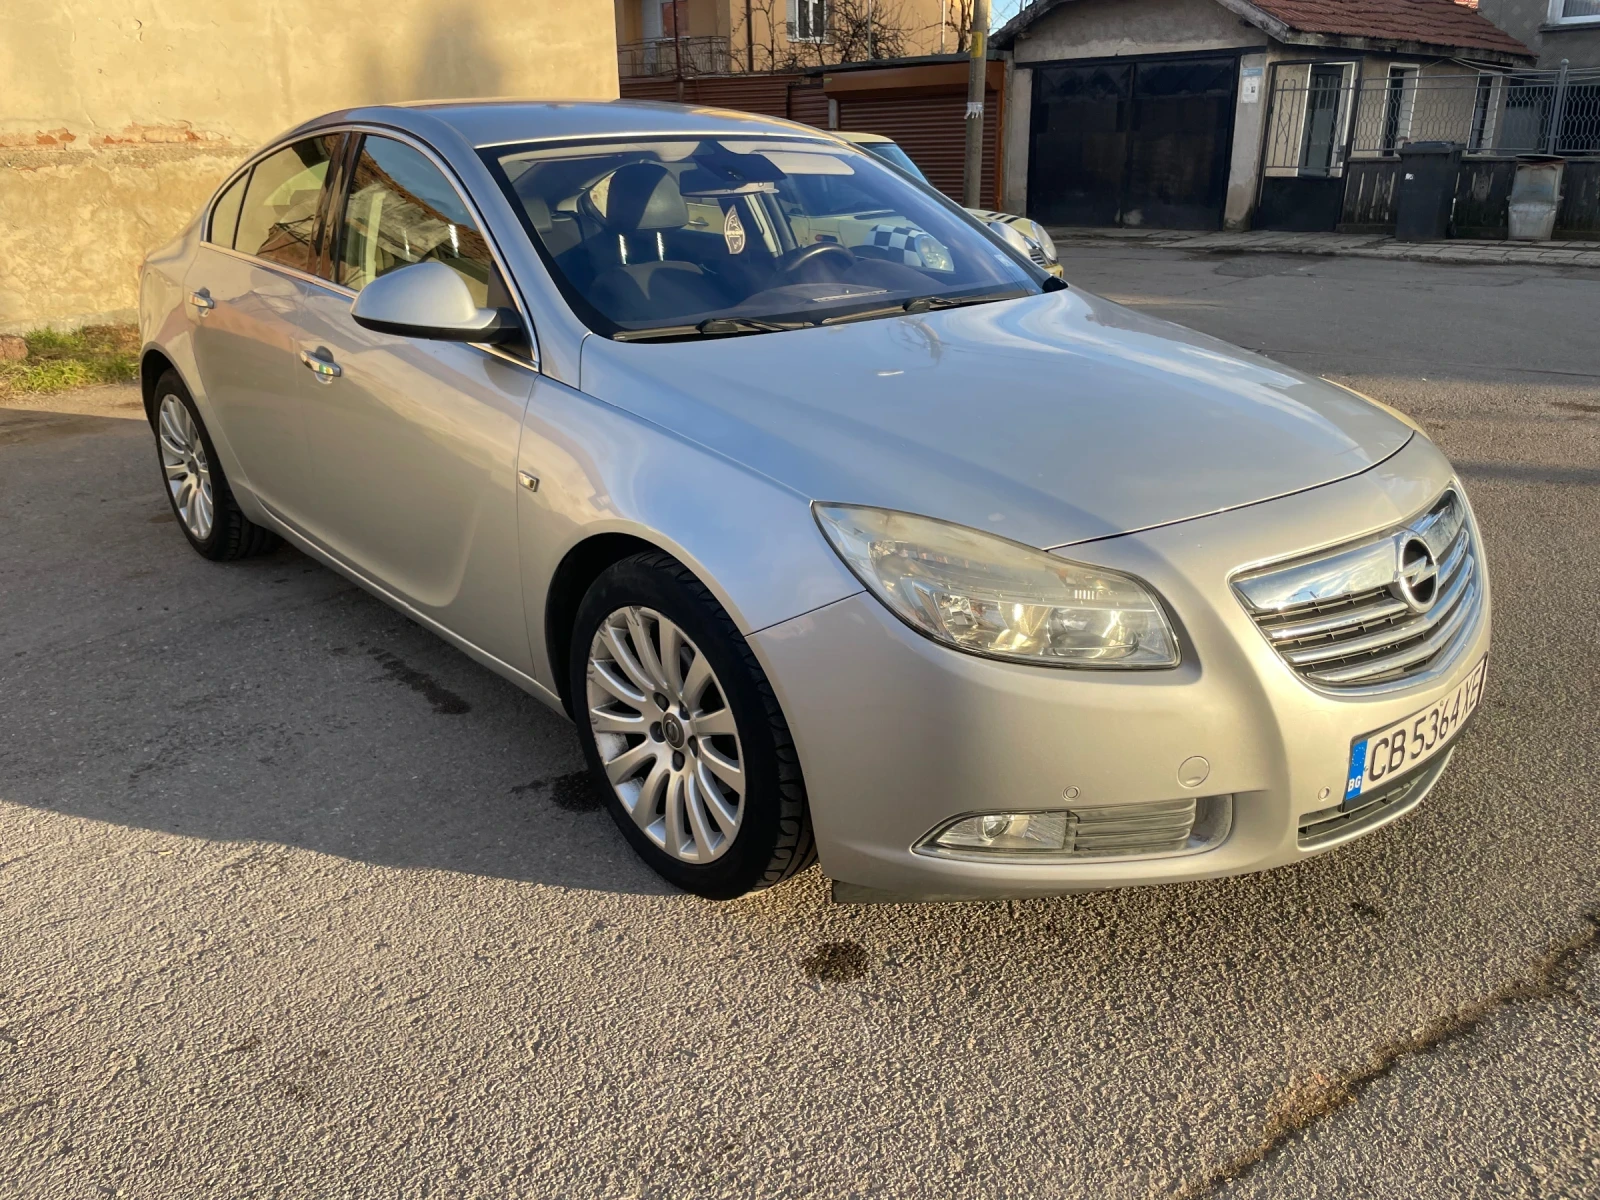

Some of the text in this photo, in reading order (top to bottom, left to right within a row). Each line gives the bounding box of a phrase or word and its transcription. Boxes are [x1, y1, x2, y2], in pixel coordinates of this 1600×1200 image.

[1368, 665, 1481, 782] CB 5364 XE
[1347, 775, 1362, 792] BG
